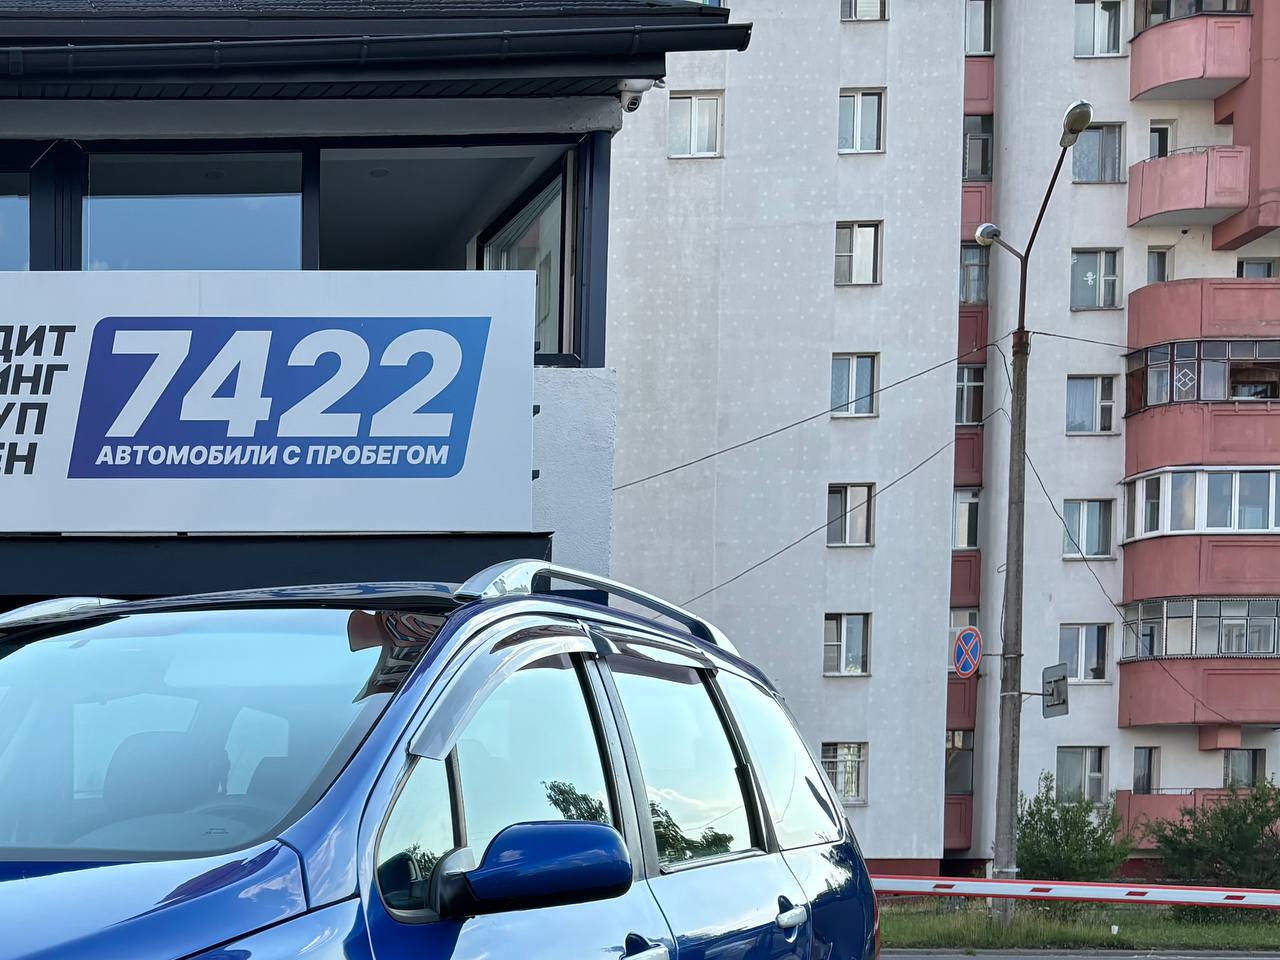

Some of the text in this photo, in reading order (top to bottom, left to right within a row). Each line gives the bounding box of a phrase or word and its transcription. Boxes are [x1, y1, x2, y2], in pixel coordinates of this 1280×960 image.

[104, 328, 463, 438] 7422
[94, 445, 450, 465] АВТОМОБИЛИ С ПРОБЕГОМ
